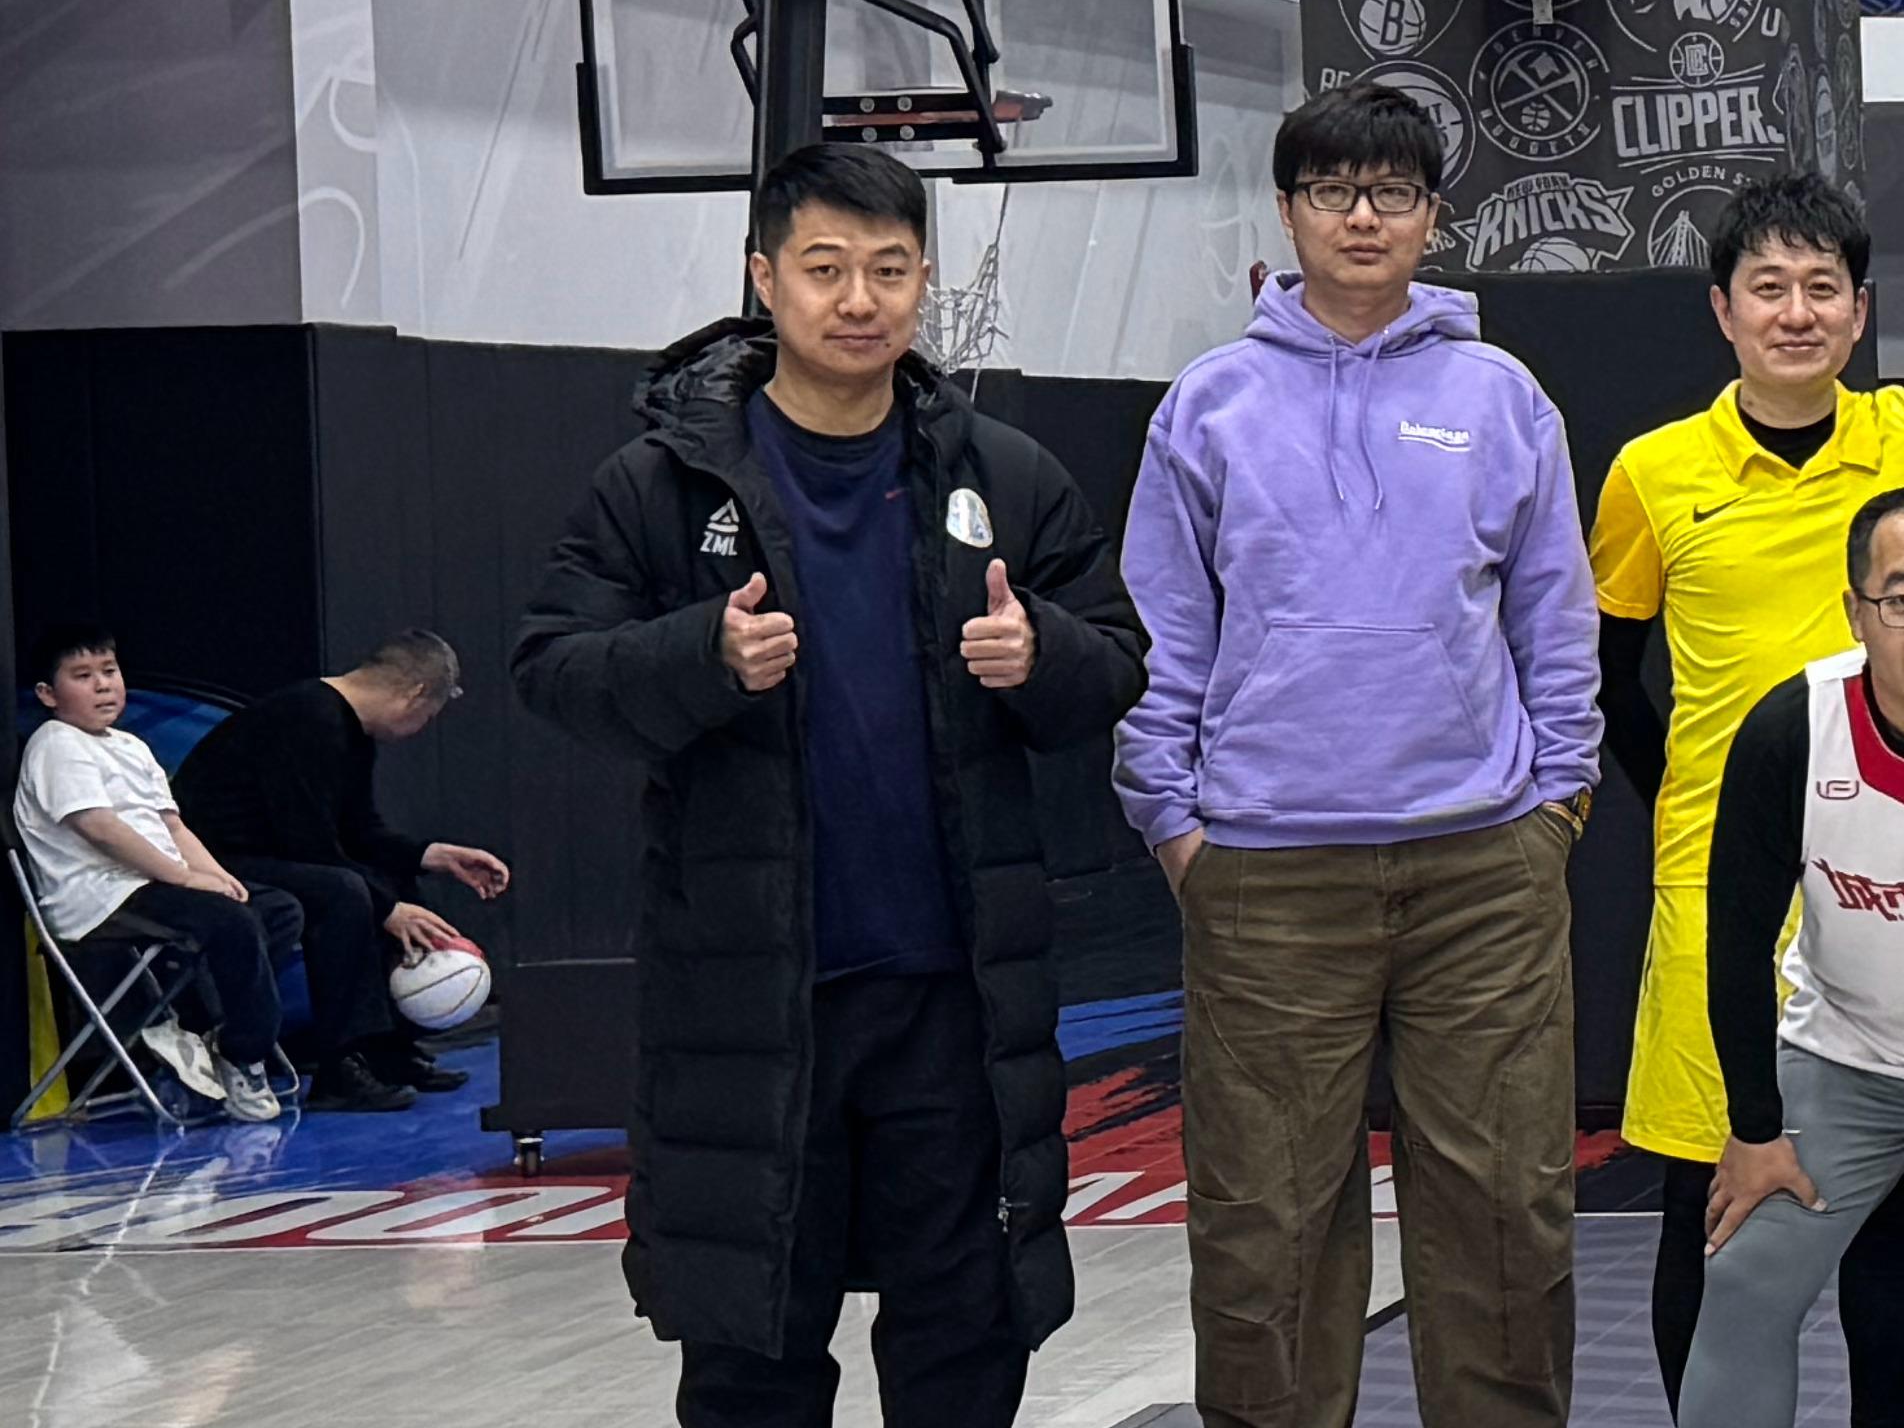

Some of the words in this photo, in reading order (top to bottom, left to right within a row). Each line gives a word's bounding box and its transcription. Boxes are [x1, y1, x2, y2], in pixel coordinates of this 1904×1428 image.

[1652, 164, 1726, 198] GOLDEN
[1474, 188, 1623, 263] KNICKS
[700, 530, 738, 556] ZML
